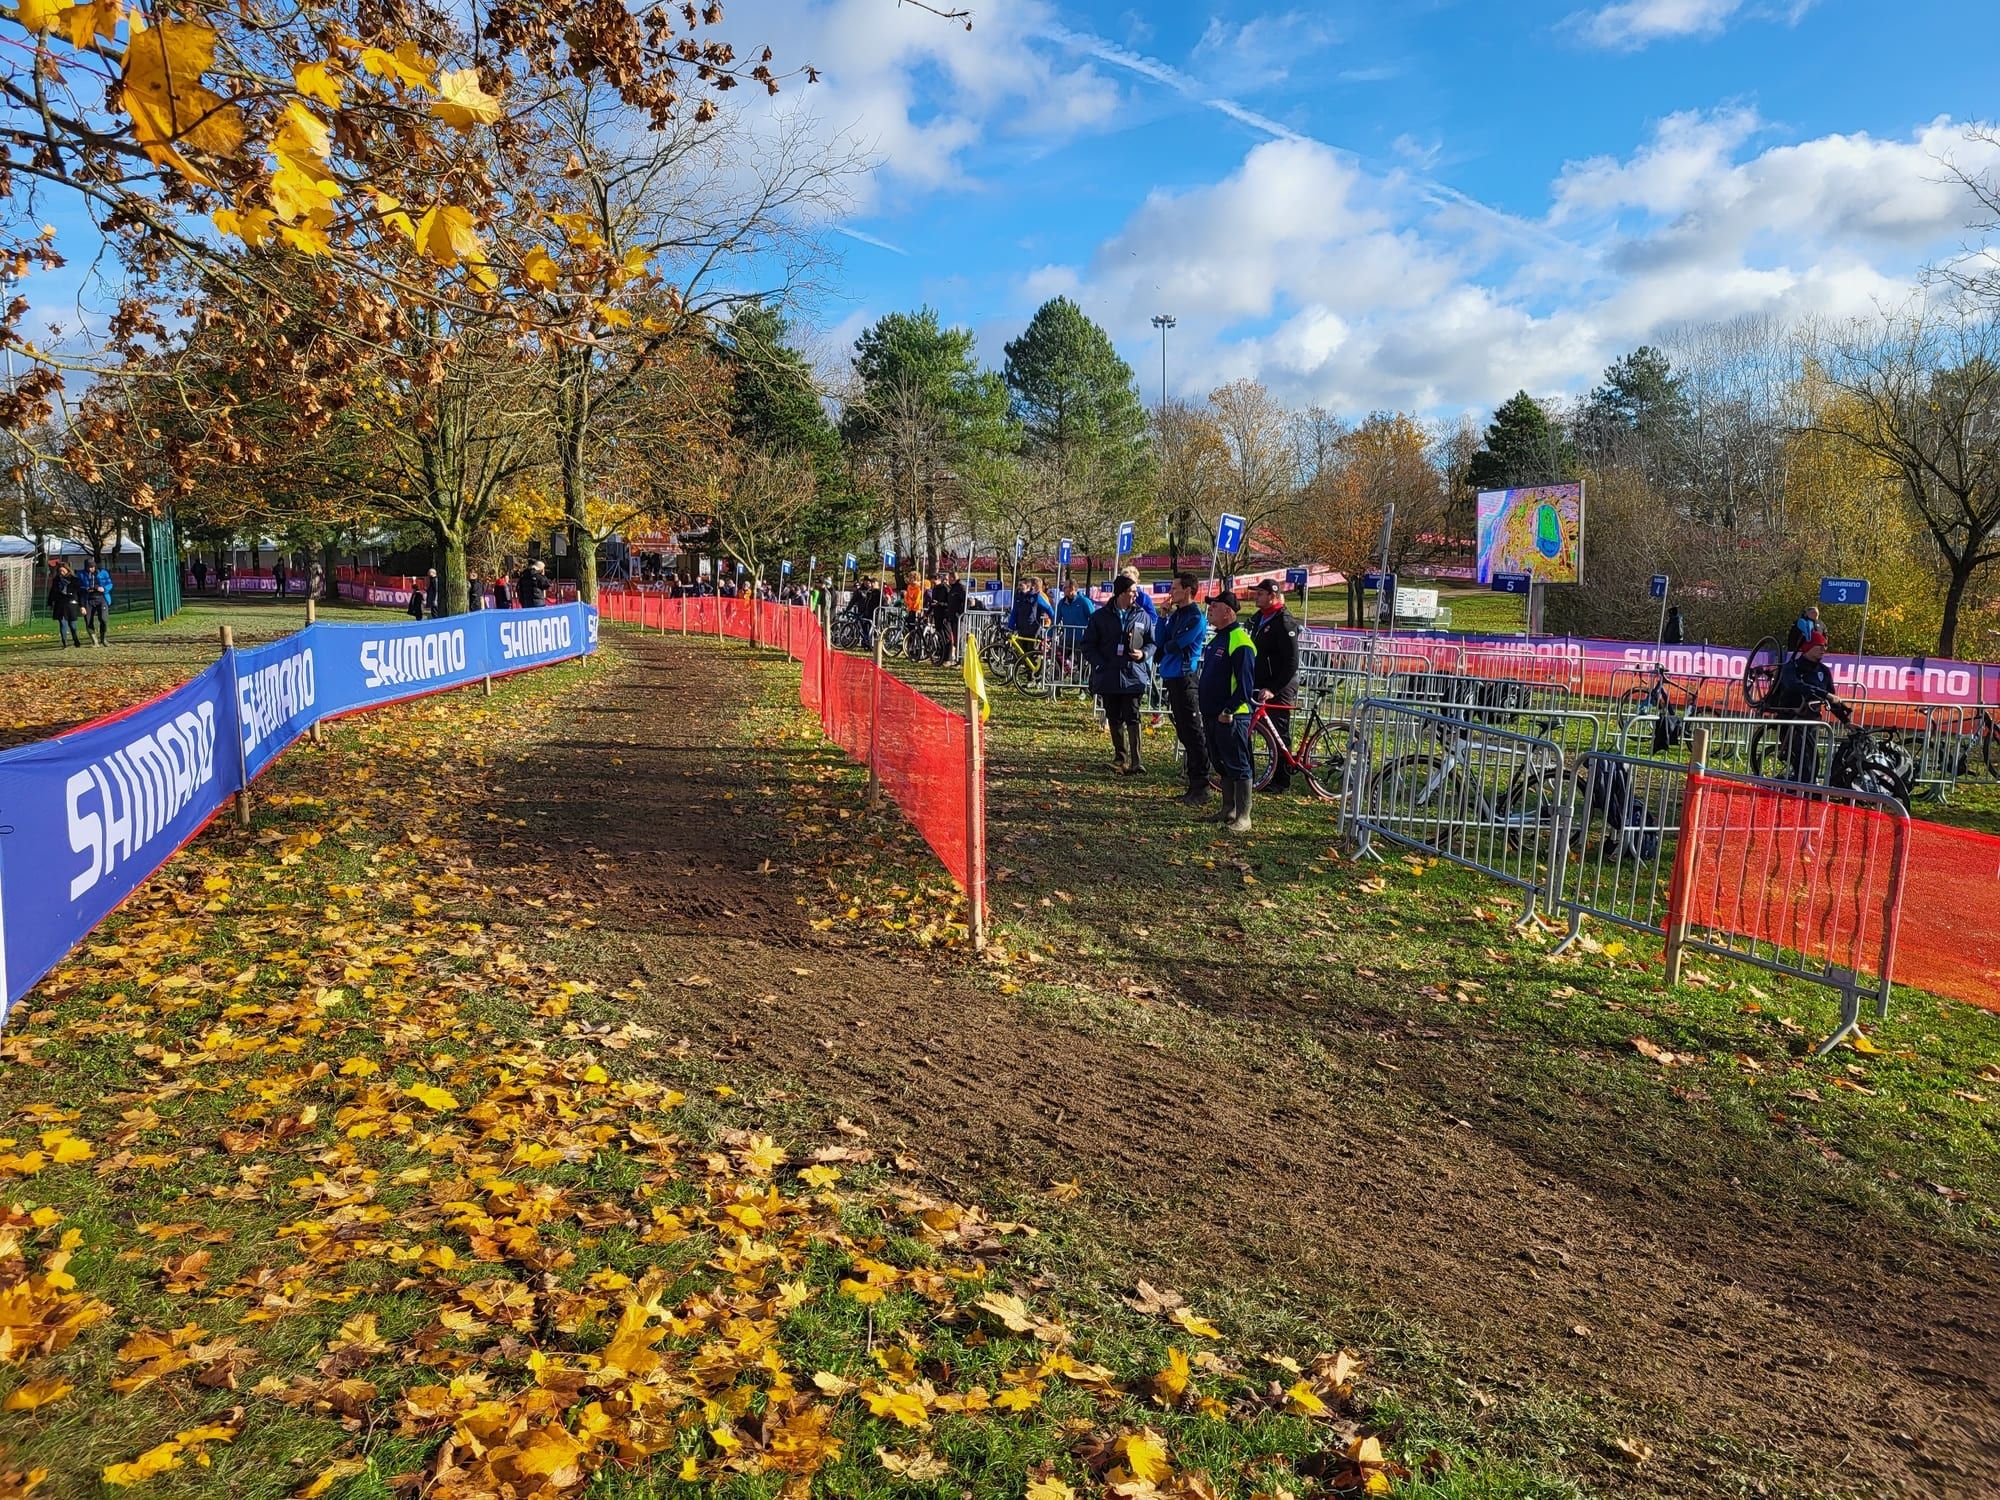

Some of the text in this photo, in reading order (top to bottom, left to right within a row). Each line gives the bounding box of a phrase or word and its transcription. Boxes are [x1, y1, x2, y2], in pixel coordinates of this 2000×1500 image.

[1223, 529, 1233, 549] 2
[1294, 574, 1299, 583] 7
[1506, 580, 1515, 592] 5
[1827, 580, 1862, 589] SHIMANO
[1837, 587, 1848, 602] 3
[499, 615, 571, 659] SHIMANO
[360, 628, 466, 688] SHIMANO
[1624, 648, 1750, 679] SHIMANO
[1823, 662, 1970, 697] HIMANO
[238, 647, 315, 757] SHIMANO
[66, 699, 216, 903] SHIMANO
